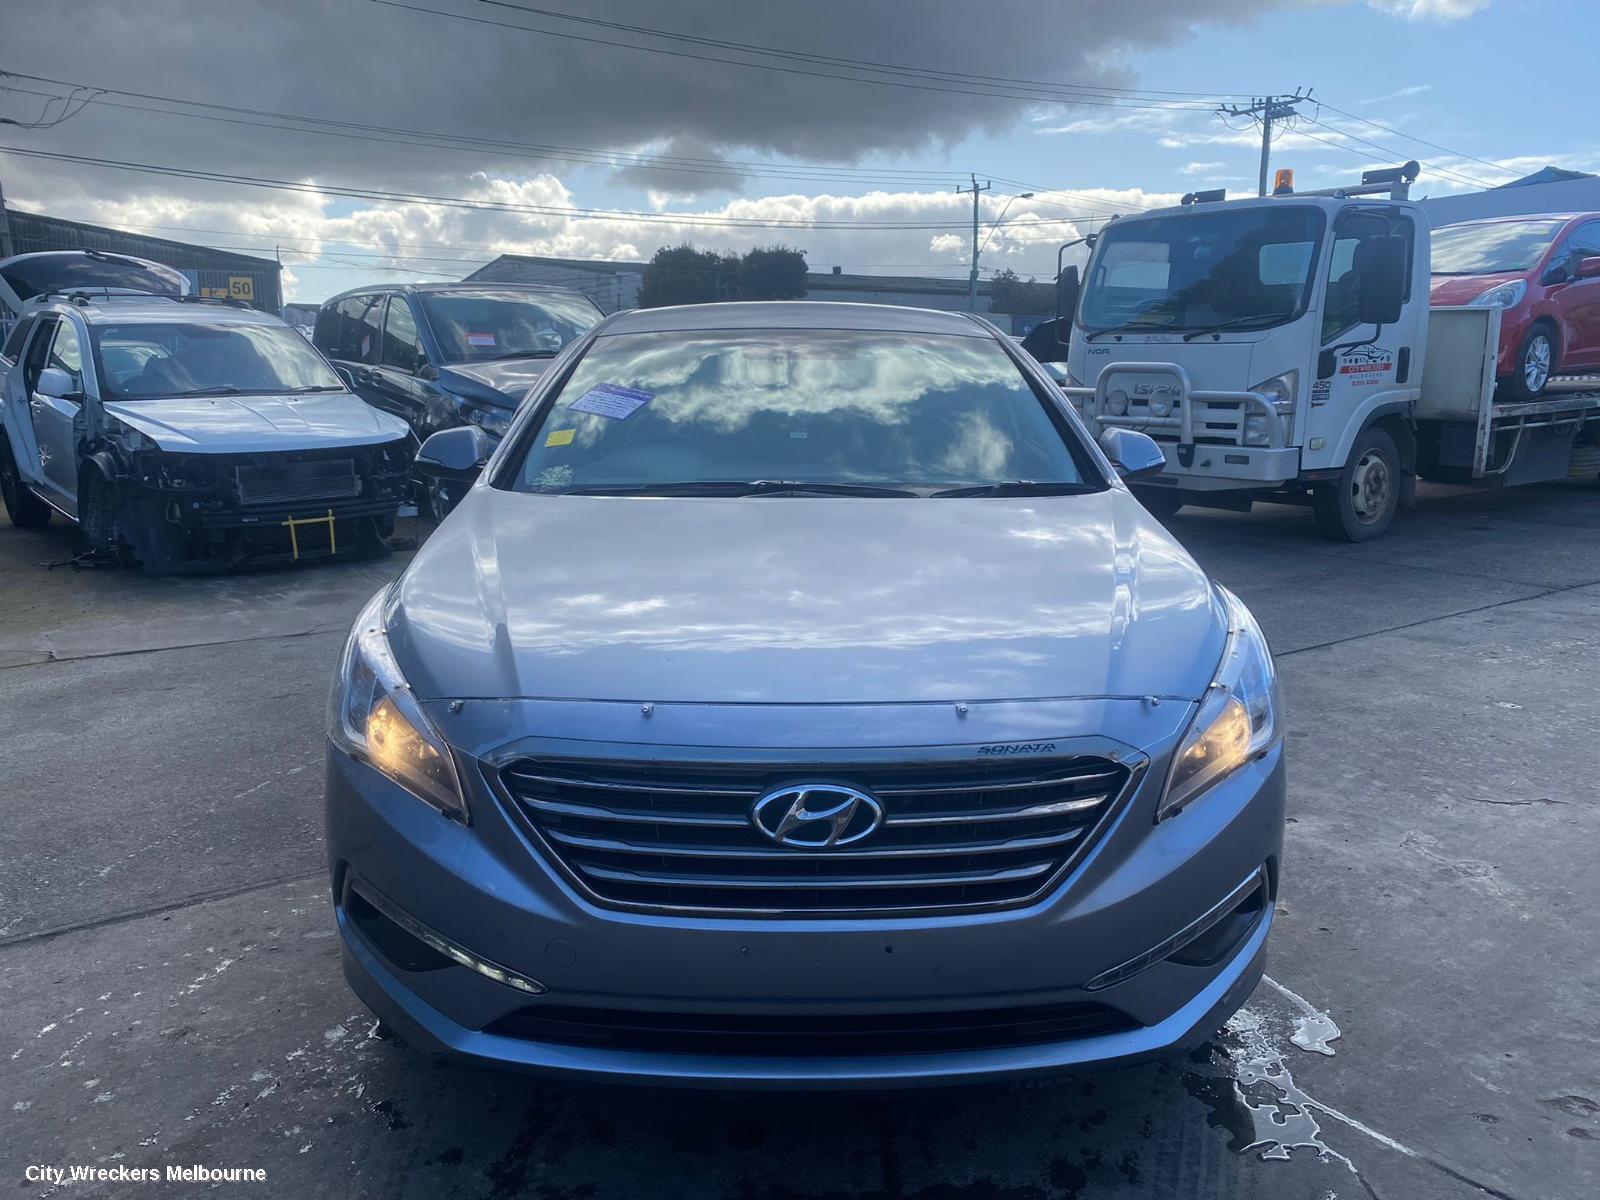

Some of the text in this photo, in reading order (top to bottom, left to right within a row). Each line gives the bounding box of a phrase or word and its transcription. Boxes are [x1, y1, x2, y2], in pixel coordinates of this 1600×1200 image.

[232, 281, 251, 295] 50
[1312, 381, 1331, 389] 450
[977, 743, 1057, 755] SONATA
